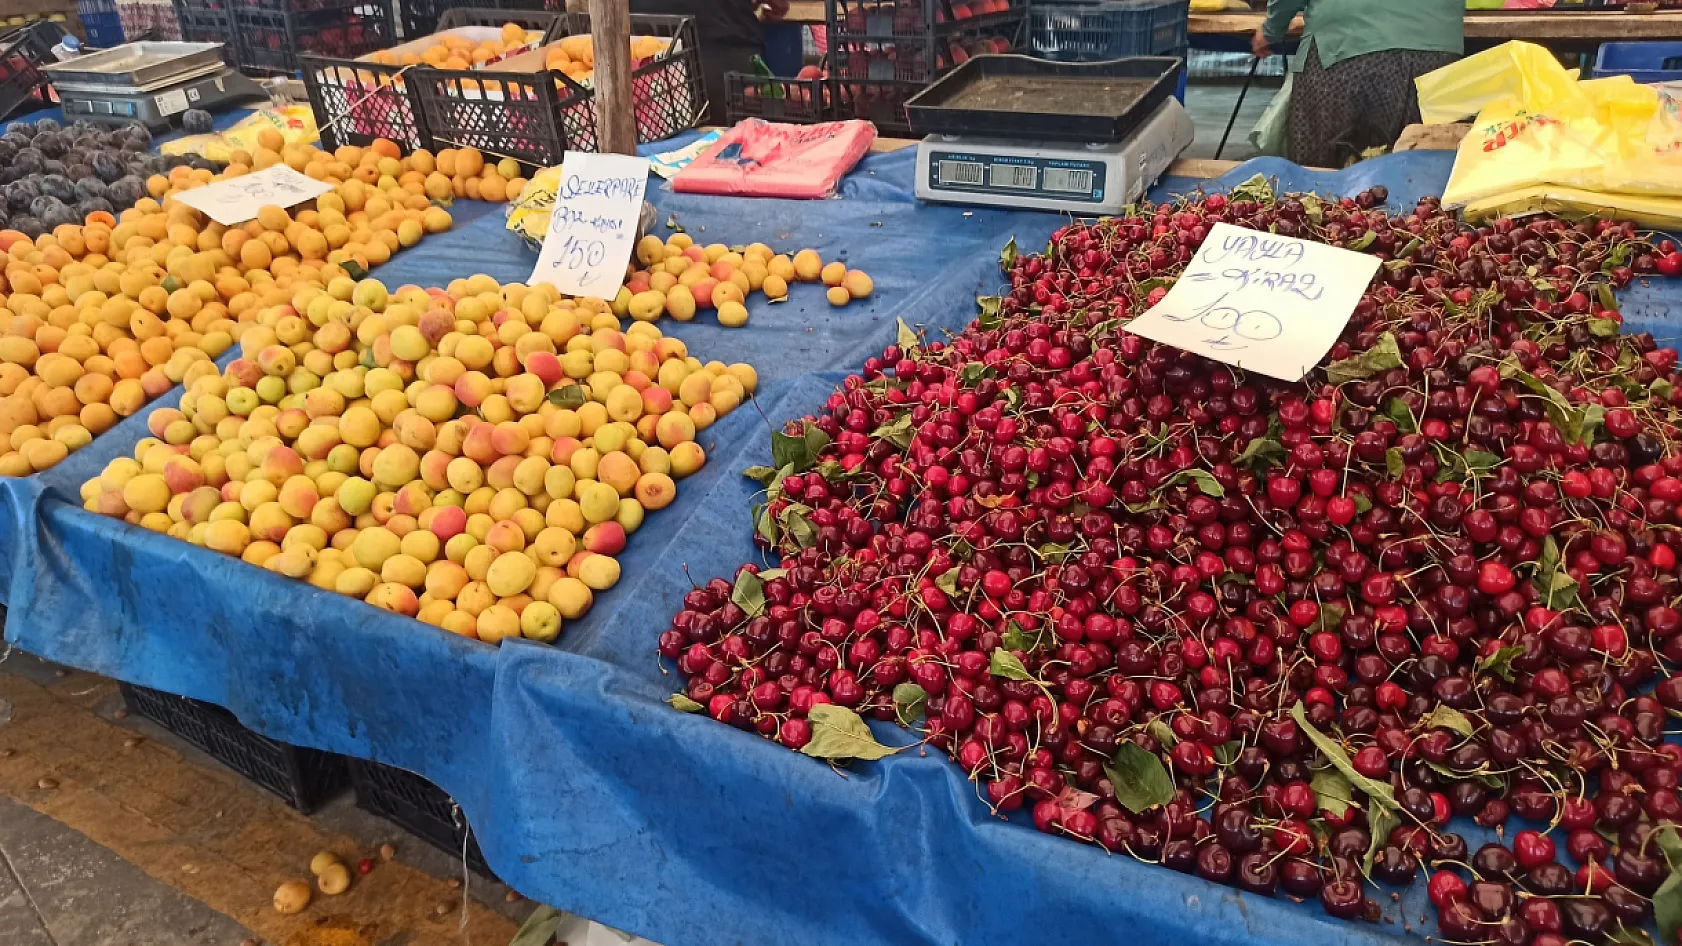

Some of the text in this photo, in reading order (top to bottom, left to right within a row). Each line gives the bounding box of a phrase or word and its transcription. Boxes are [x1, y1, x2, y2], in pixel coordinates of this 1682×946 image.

[552, 235, 606, 270] 150
[1203, 235, 1305, 270] YAYLA
[1161, 291, 1283, 341] 100
